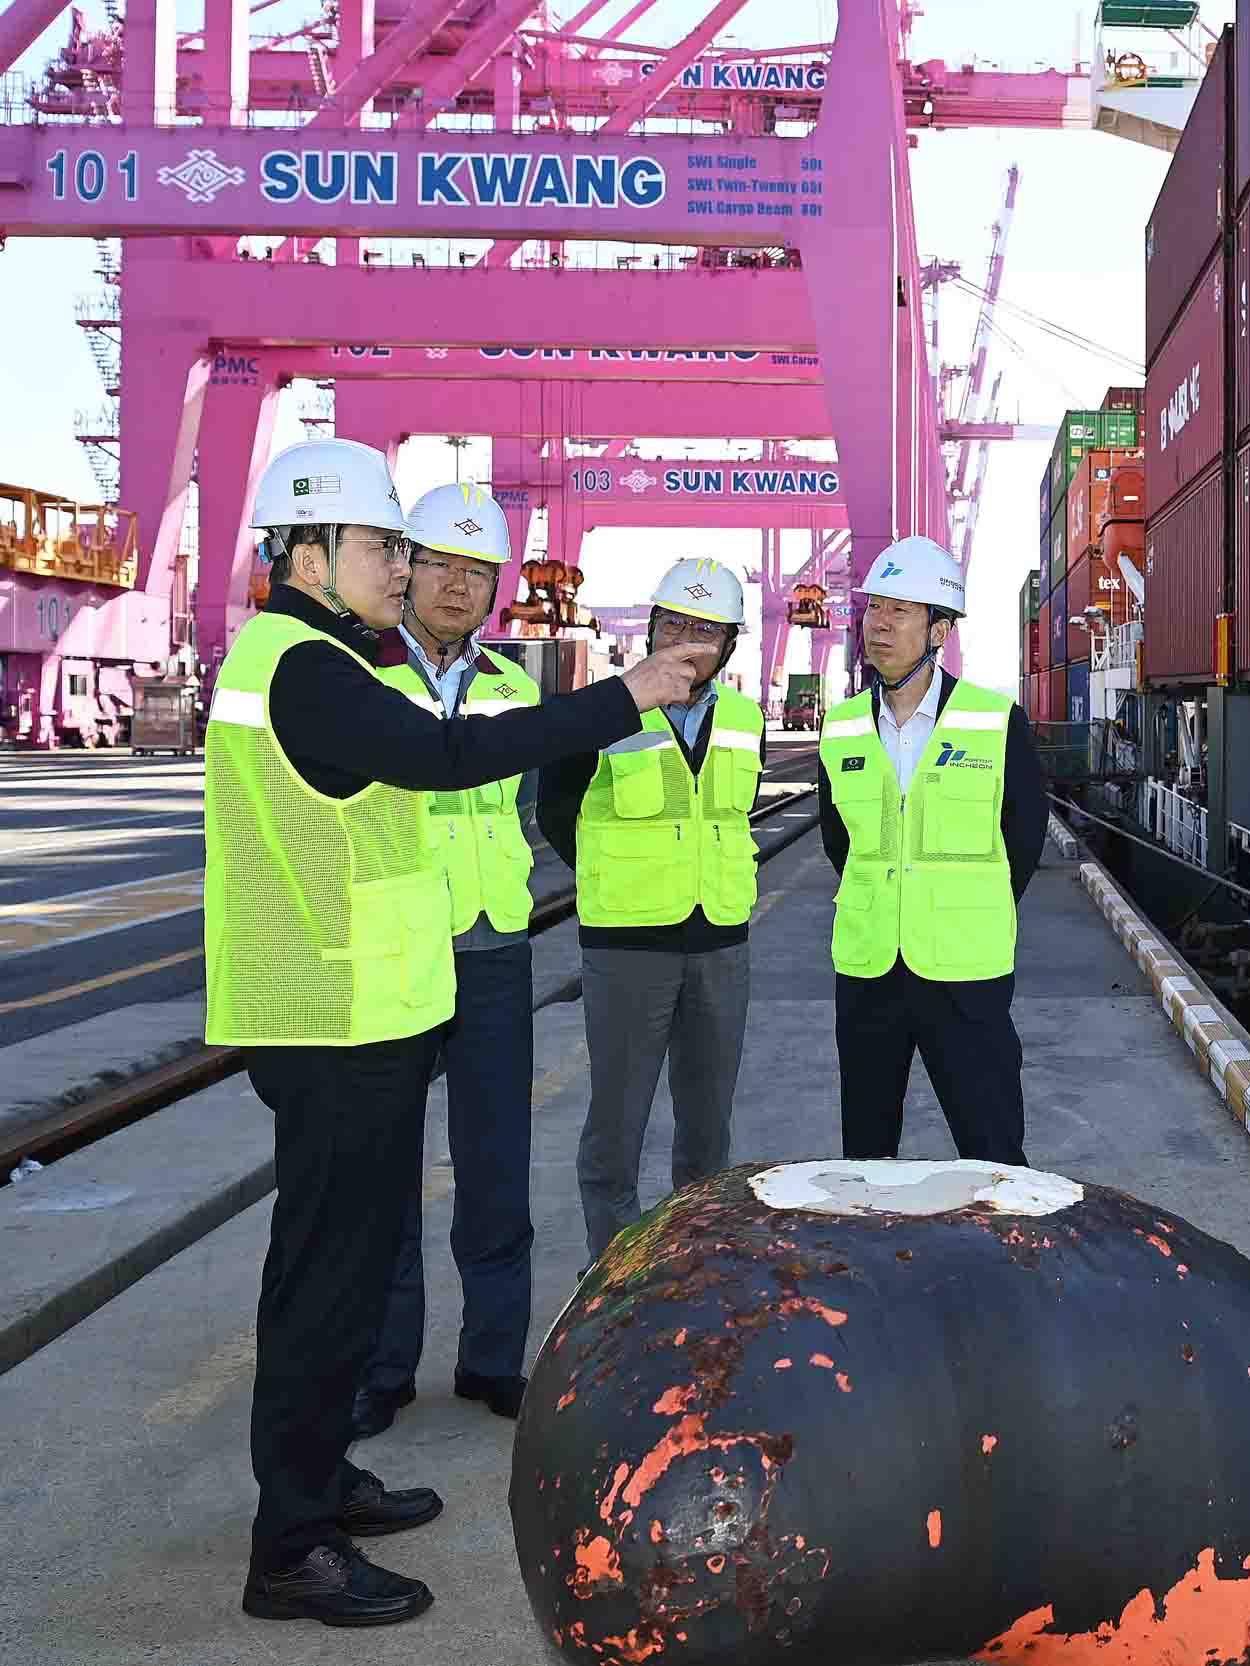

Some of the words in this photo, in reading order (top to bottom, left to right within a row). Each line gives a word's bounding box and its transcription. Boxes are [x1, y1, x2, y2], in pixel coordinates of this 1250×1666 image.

[641, 63, 703, 89] SN
[711, 63, 826, 90] KWANG
[687, 155, 713, 169] SWL
[47, 149, 137, 203] 101
[260, 150, 399, 205] SUN
[417, 152, 666, 208] KWANG
[687, 178, 713, 192] SWL
[687, 200, 713, 215] SWL
[214, 356, 258, 374] PMC
[571, 470, 611, 492] 103
[664, 470, 723, 494] SUN
[731, 471, 839, 495] KWANG
[1098, 576, 1120, 590] tex
